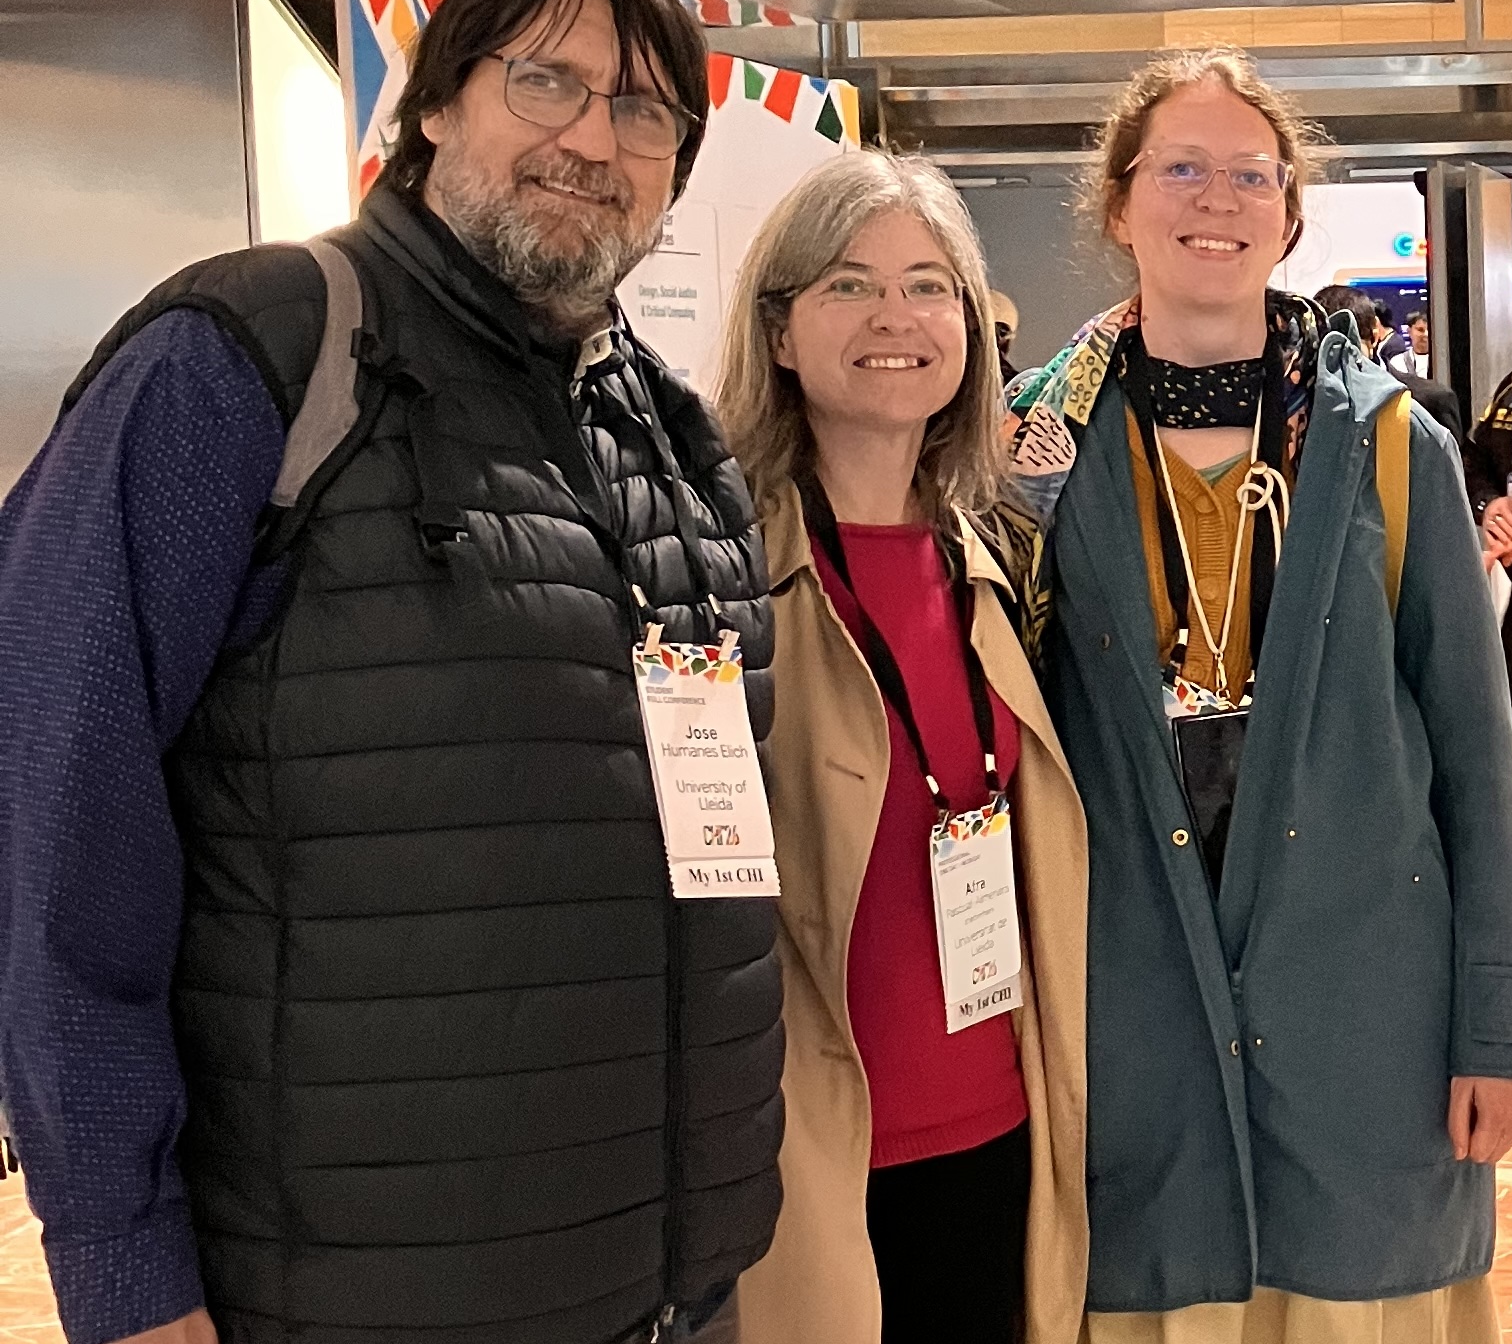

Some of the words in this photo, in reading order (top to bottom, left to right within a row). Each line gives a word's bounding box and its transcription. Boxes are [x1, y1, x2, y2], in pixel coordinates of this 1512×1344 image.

[685, 725, 718, 740] Jose
[661, 742, 719, 758] Humanes
[676, 779, 733, 796] University
[735, 780, 747, 794] of
[688, 868, 711, 887] My
[715, 868, 734, 883] 1st
[736, 867, 764, 883] CHI
[959, 1003, 974, 1017] My
[976, 996, 990, 1011] 1st
[991, 986, 1012, 1005] CHI
